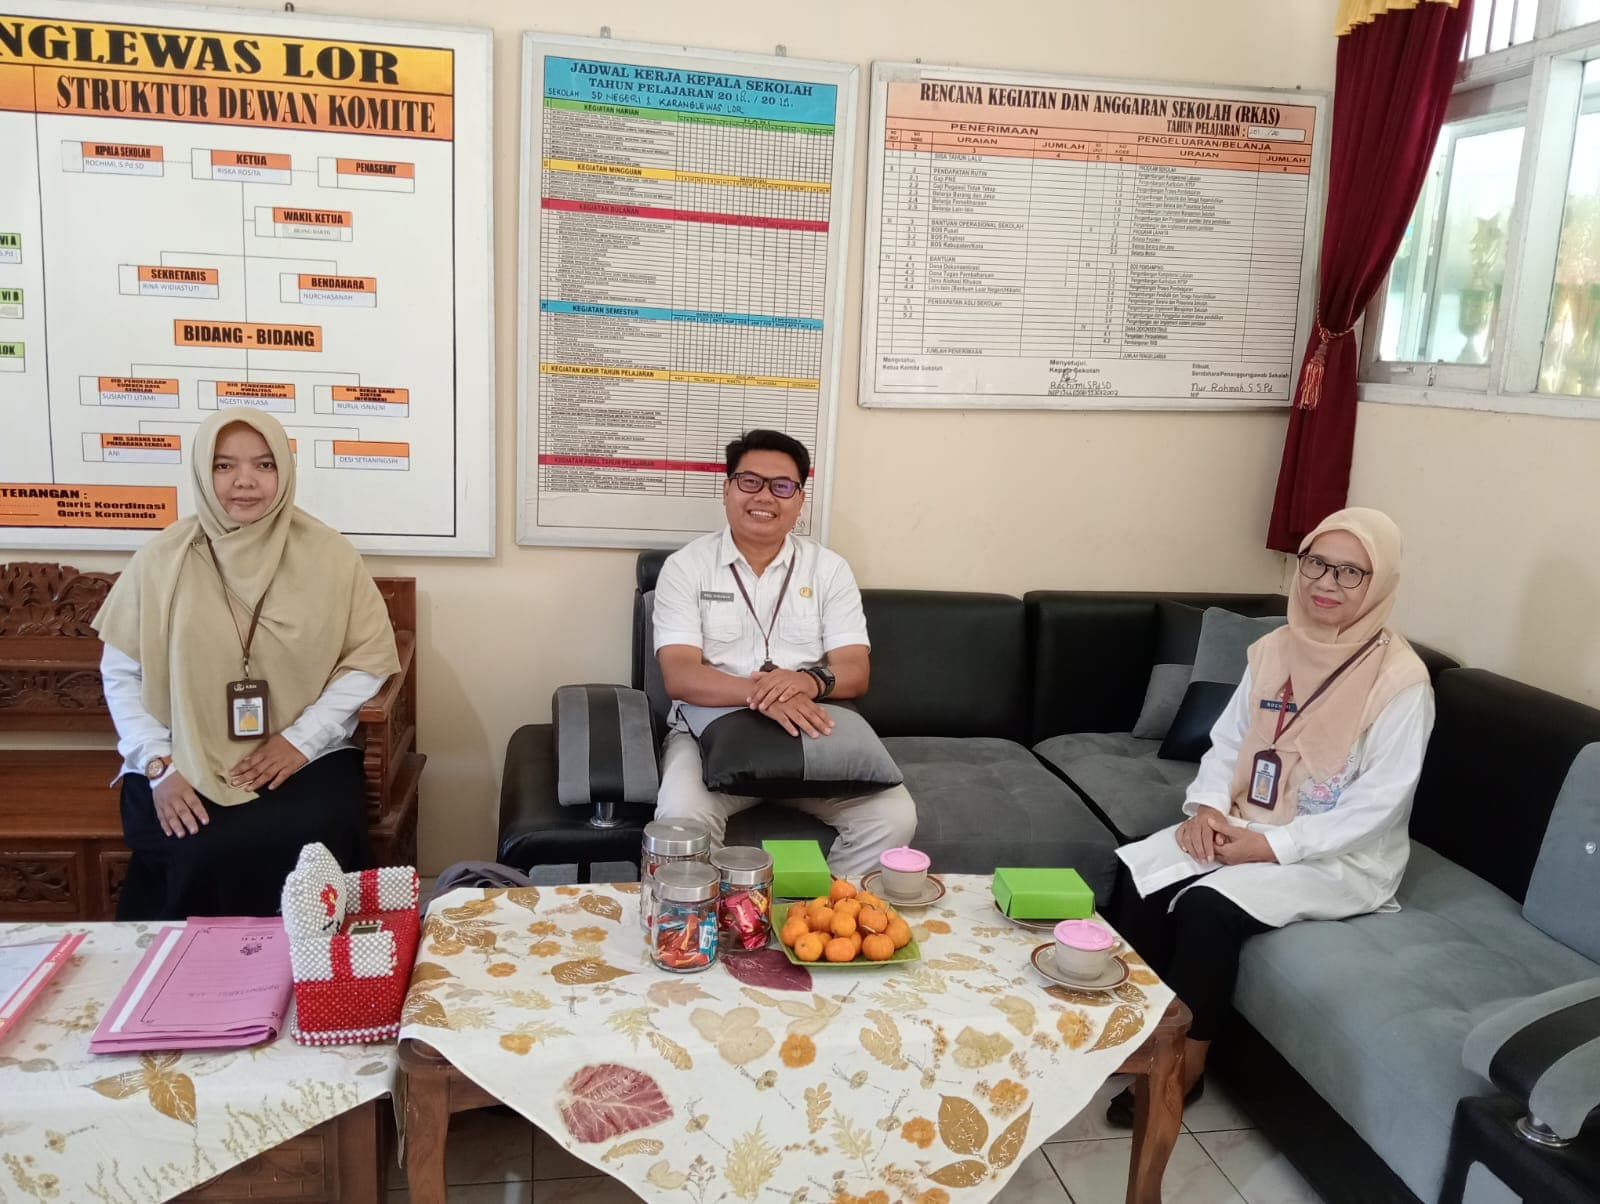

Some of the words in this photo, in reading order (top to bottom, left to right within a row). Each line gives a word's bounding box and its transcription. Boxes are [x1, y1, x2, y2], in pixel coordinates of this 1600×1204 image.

[282, 42, 400, 86] LOR
[570, 62, 630, 79] JADWAL
[633, 69, 682, 86] KERJA
[686, 74, 743, 91] KEPALA
[745, 79, 814, 98] SEKOLAH
[589, 77, 634, 92] TAHUN
[638, 82, 714, 100] PELAJARAN
[718, 91, 733, 102] 20
[761, 95, 776, 106] 20
[57, 75, 209, 118] STRUKTUR
[218, 86, 318, 125] DEWAN
[328, 95, 436, 134] KOMITE
[584, 103, 615, 115] KEGIATAN
[615, 106, 640, 117] HARIAN
[920, 83, 983, 105] RENCANA
[988, 87, 1057, 110] KEGIATAN
[1061, 92, 1090, 112] DAN
[1093, 95, 1168, 118] ANGGARAN
[1172, 100, 1232, 122] SEKOLAH
[1235, 105, 1280, 126] (RKAS)
[951, 122, 1039, 136] PENERIMAAN
[1166, 119, 1194, 134] TAHUN
[1195, 122, 1241, 138] PELAJARAN
[957, 136, 998, 146] URAIAN
[1042, 141, 1086, 151] JUMLAH
[1137, 134, 1271, 152] PENGELUARAN/BELANJA
[120, 146, 151, 159] SEKOLAH
[1180, 150, 1219, 159] URAIAN
[1266, 155, 1306, 164] JUMLAH
[236, 154, 267, 166] KETUA
[355, 162, 396, 175] PENASEHAT
[577, 163, 608, 174] KEGIATAN
[609, 166, 642, 177] MINGGUAN
[610, 205, 640, 215] BULANAN
[283, 210, 314, 223] WAKIL
[315, 213, 344, 225] KETUA
[151, 268, 207, 282] SEKRETARIS
[311, 277, 365, 291] BENDAHARA
[572, 303, 604, 314] KEGIATAN
[605, 306, 639, 317] SEMESTER
[183, 325, 243, 344] BIDANG
[256, 328, 315, 348] BIDANG
[551, 365, 579, 375] KEGIATAN
[581, 366, 601, 376] AKHIR
[601, 368, 620, 377] TAHUN
[621, 369, 655, 379] PELAJARAN
[57, 500, 91, 509] Garis
[94, 501, 166, 511] Koordinasi
[58, 510, 92, 518] Garis
[95, 510, 157, 520] Komando
